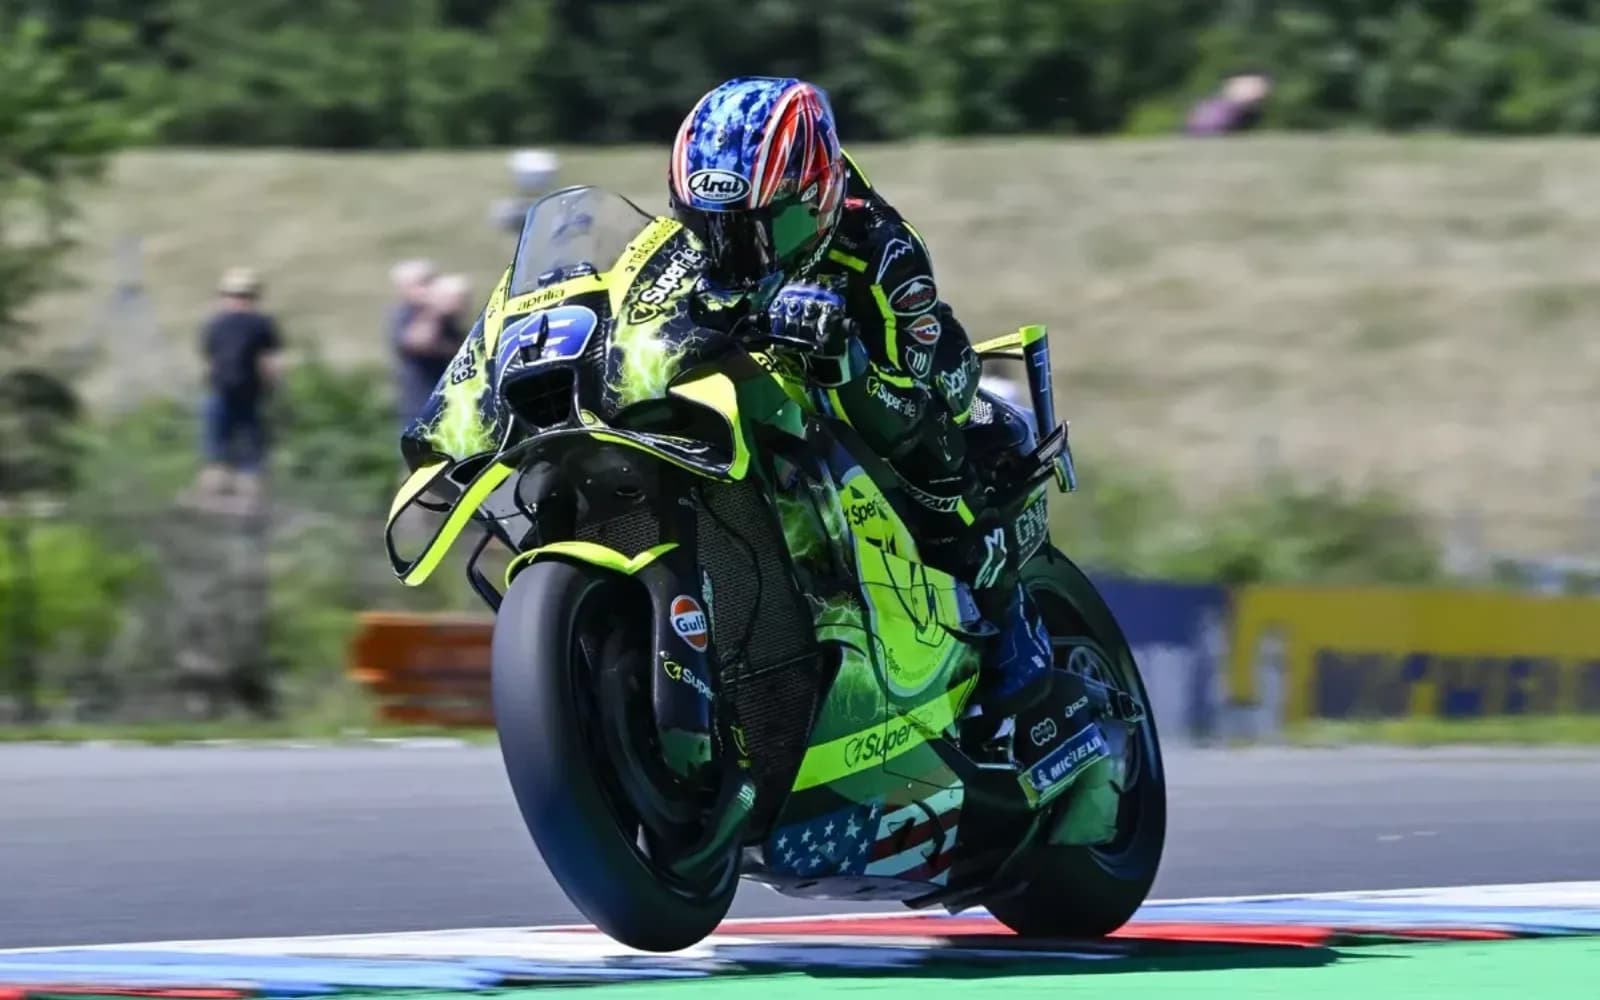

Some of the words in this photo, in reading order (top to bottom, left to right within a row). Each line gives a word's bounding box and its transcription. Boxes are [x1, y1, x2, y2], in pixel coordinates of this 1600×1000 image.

[692, 174, 741, 193] Arai
[517, 288, 565, 311] aprilia
[676, 616, 705, 632] Gulf
